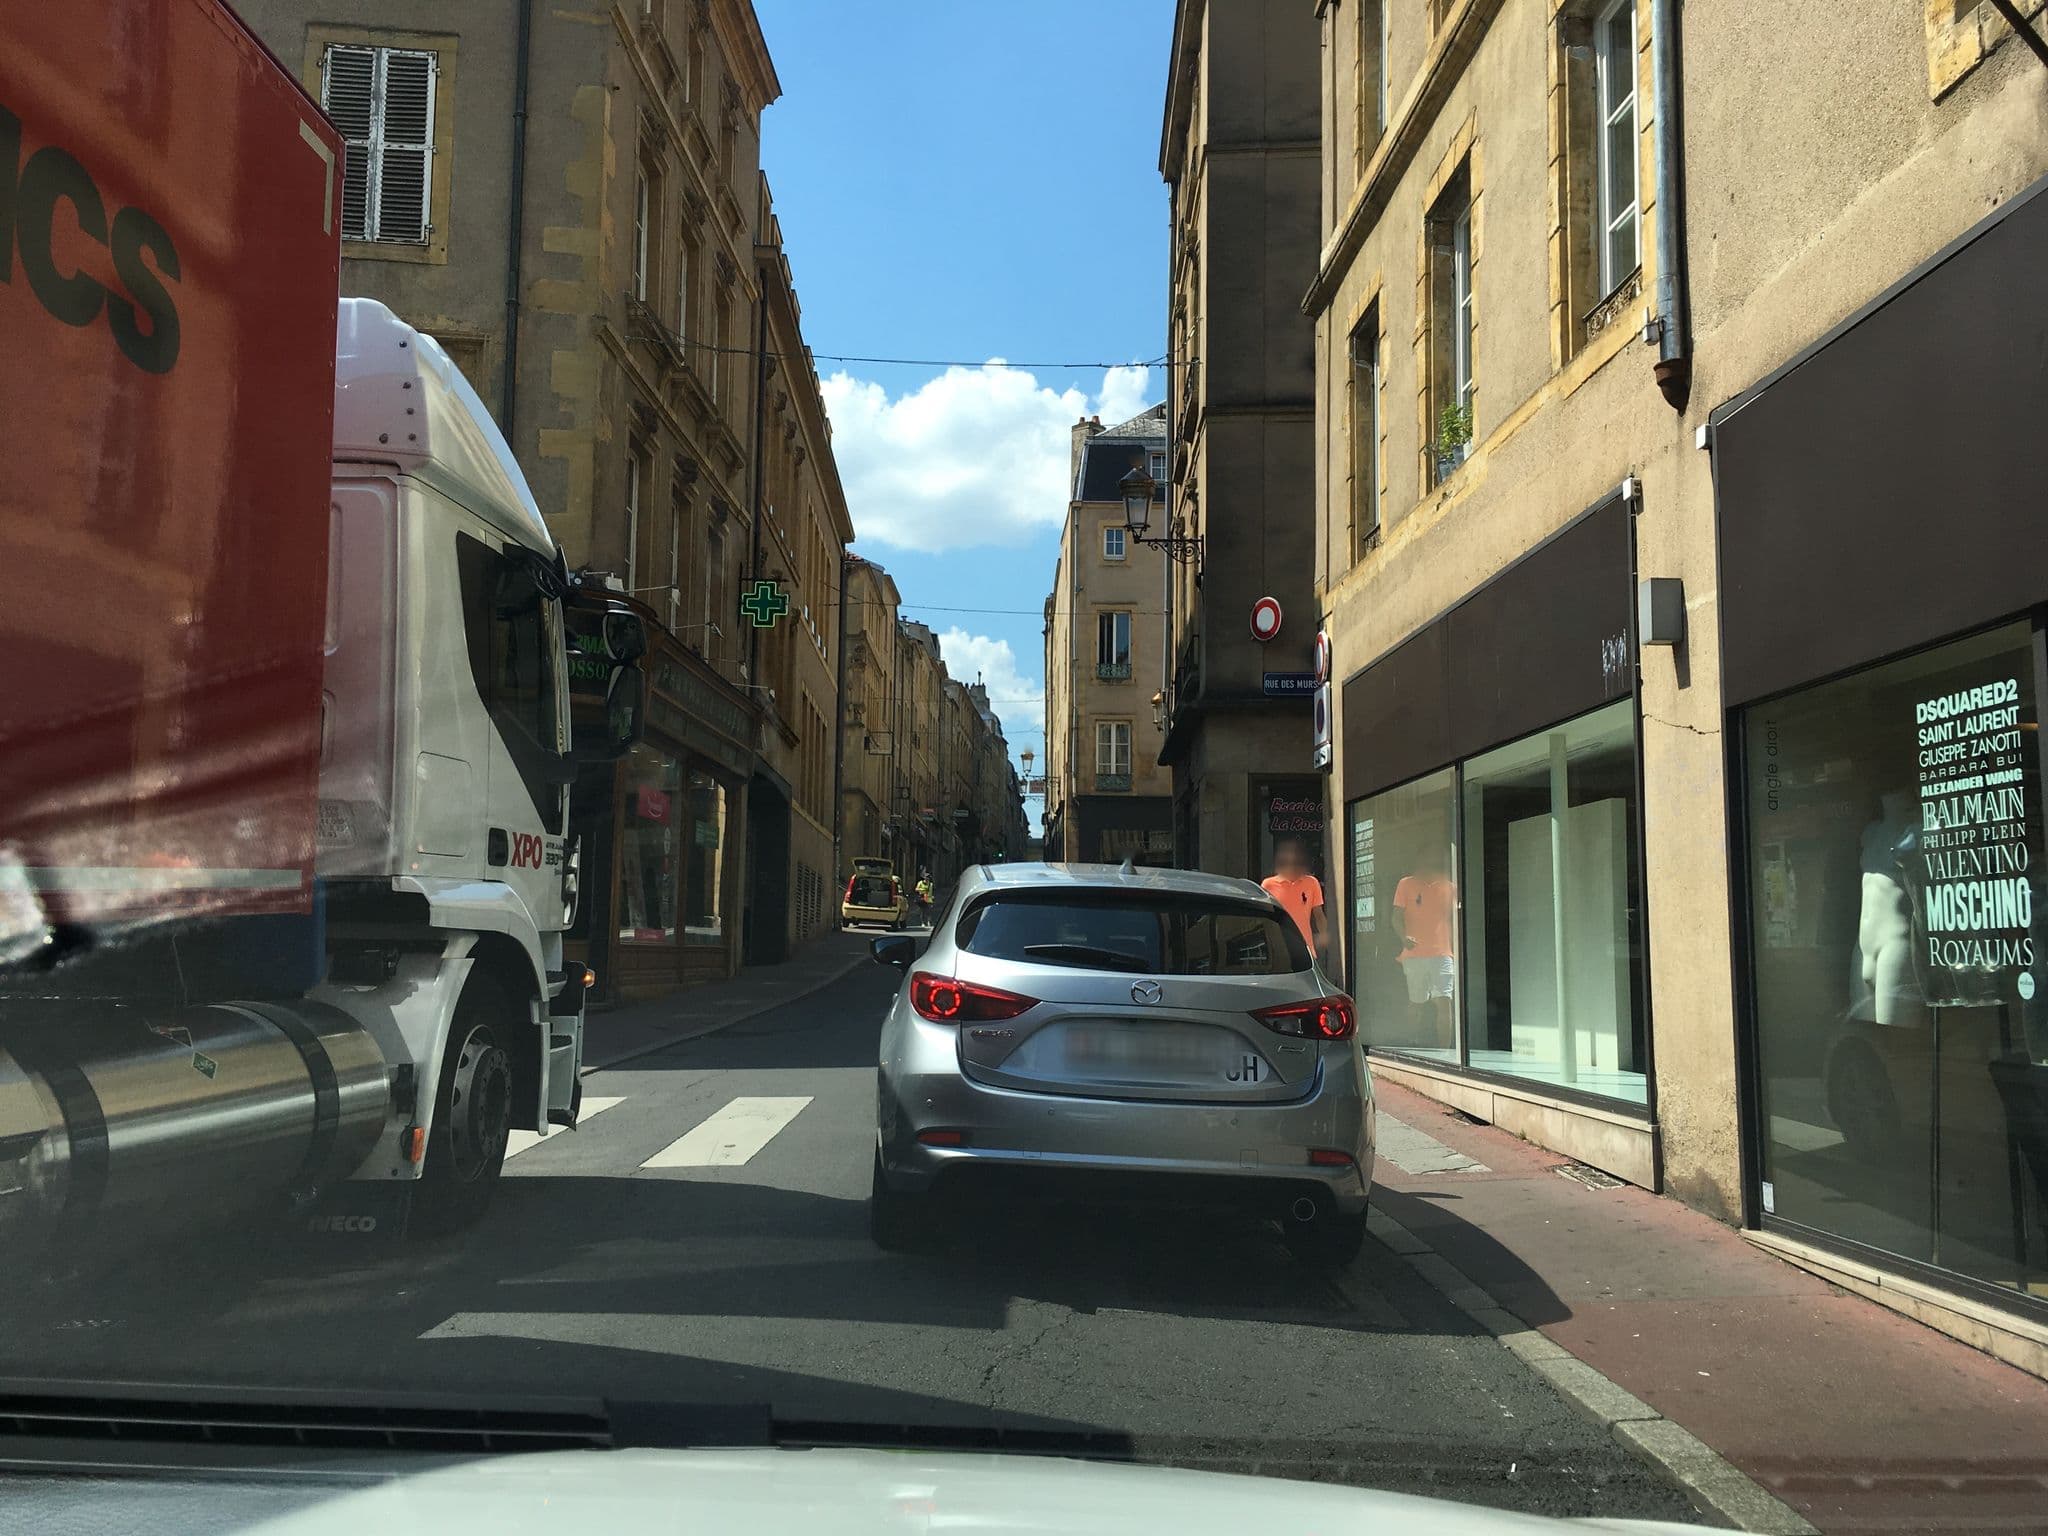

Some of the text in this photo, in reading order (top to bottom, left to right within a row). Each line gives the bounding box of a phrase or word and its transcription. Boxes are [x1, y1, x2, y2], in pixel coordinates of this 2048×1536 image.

[1264, 679, 1319, 689] RUE DES MURS
[1916, 679, 2018, 724] DSQUARED2
[1918, 705, 2020, 747] SAINT LAURENT
[1919, 730, 2021, 767] GIUSEPPE ZANOTTI
[1920, 753, 2022, 781] BARBARA BUI
[1765, 764, 1781, 811] angle
[1921, 768, 2023, 797] ALEXANDER WANG
[1271, 816, 1289, 831] La
[1922, 786, 2025, 831] BALMAIN
[511, 831, 542, 870] XPO
[1923, 822, 2026, 849] PHILIPP PLEIN
[1925, 841, 2028, 880] VALENTINO
[1926, 876, 2031, 932] MOSCHINO
